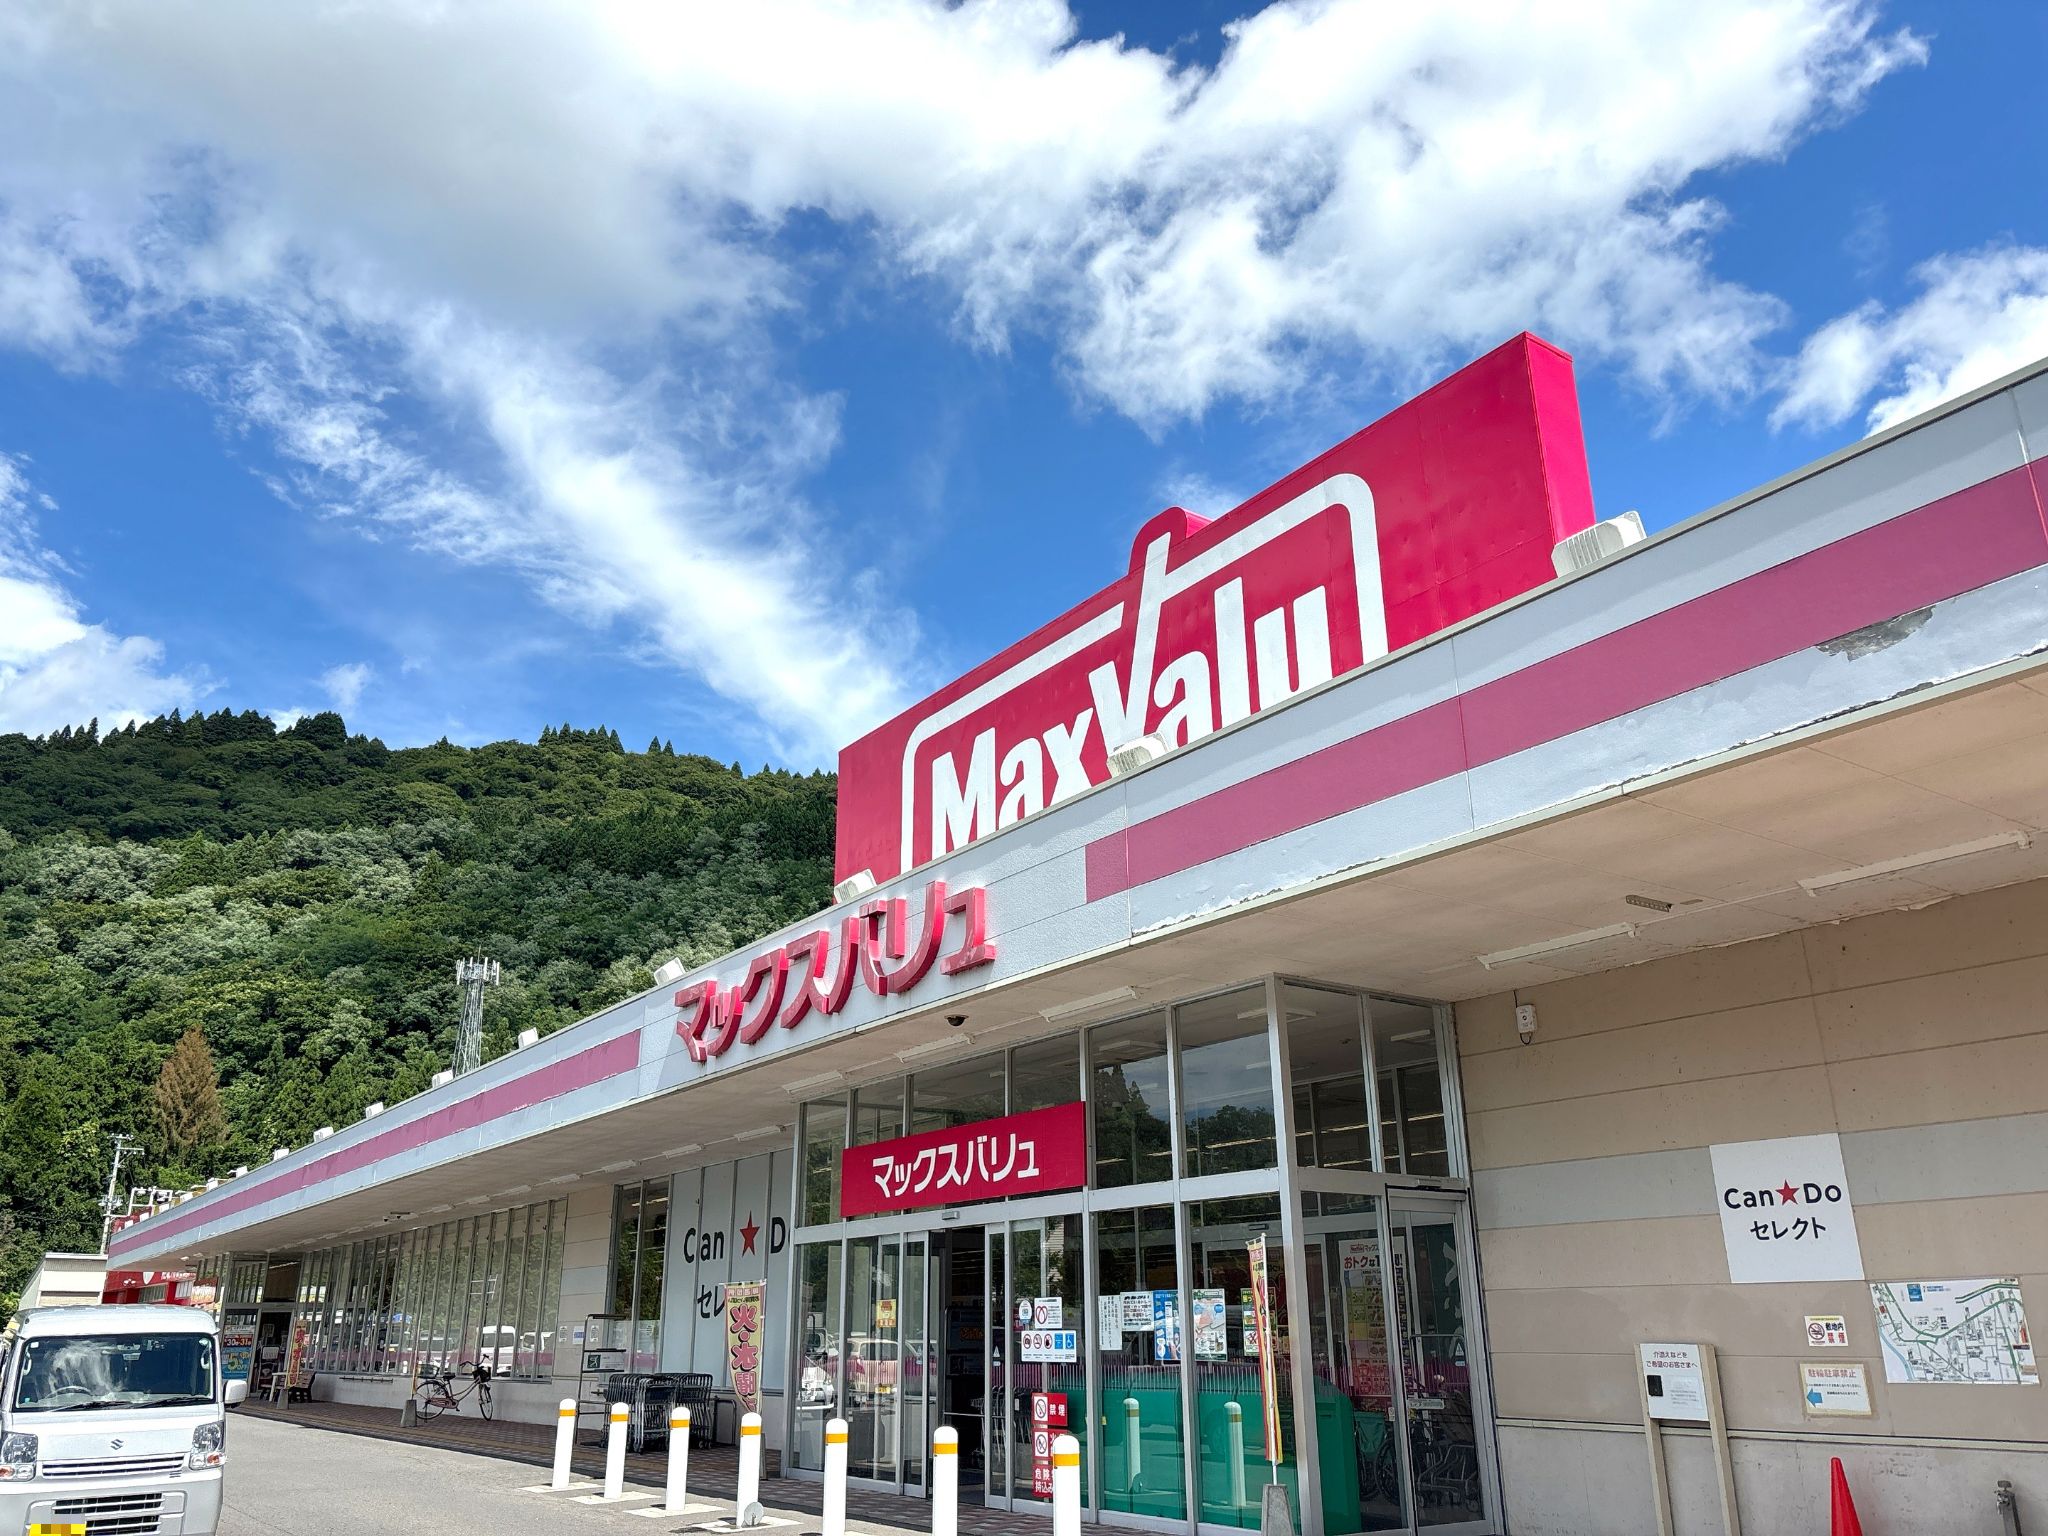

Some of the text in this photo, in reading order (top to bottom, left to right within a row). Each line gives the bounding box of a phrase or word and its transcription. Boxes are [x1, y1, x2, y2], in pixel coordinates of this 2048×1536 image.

[932, 531, 1334, 860] MaxValu
[675, 880, 996, 1063] マックスバリュ
[872, 1133, 1040, 1198] マックスバリュ
[770, 1217, 791, 1254] D
[1750, 1217, 1826, 1241] セレクト
[1049, 1403, 1066, 1417] 禁煙
[1034, 1468, 1053, 1481] 危険
